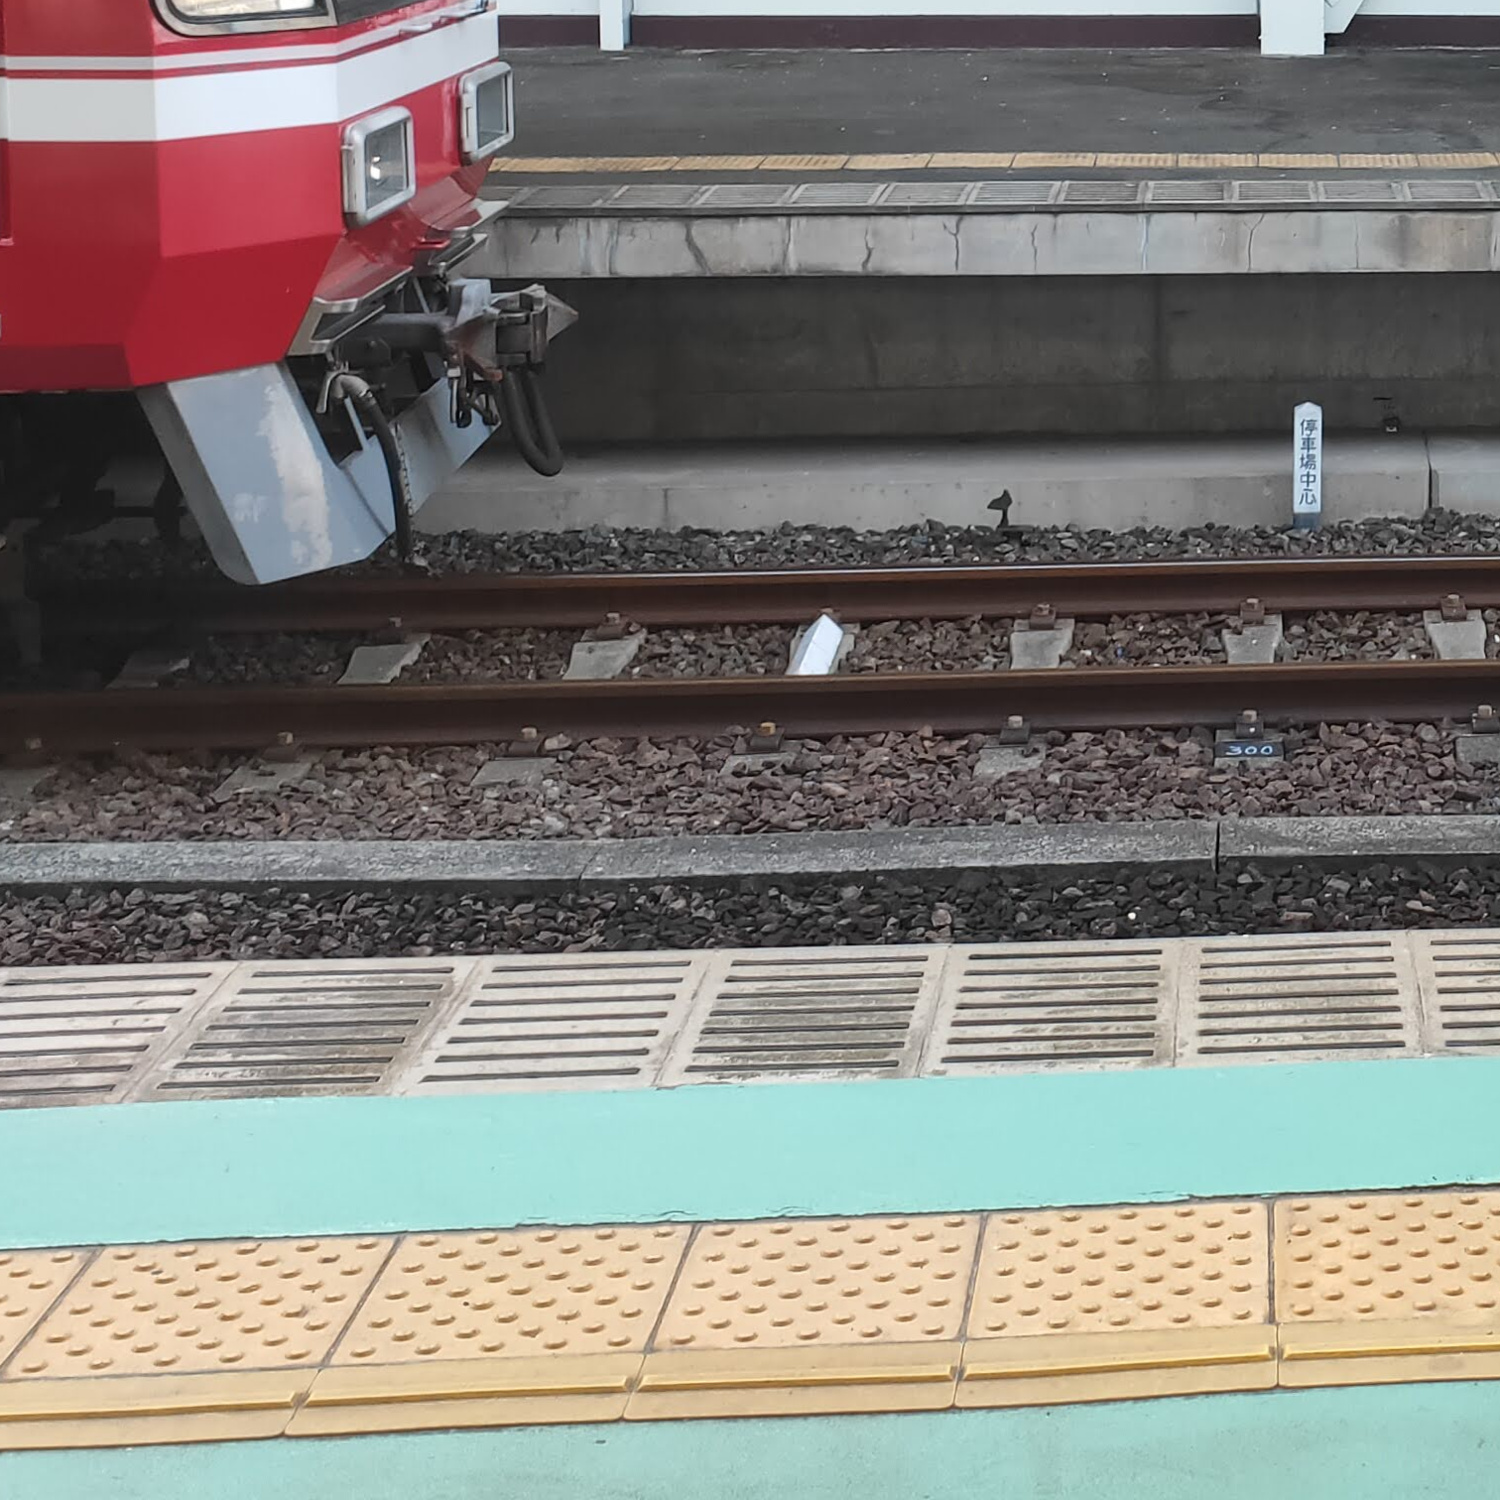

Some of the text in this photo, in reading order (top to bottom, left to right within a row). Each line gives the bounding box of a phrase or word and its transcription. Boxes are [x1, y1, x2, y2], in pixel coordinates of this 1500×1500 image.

[1299, 418, 1318, 505] 停車場中心
[1225, 745, 1274, 756] 300
